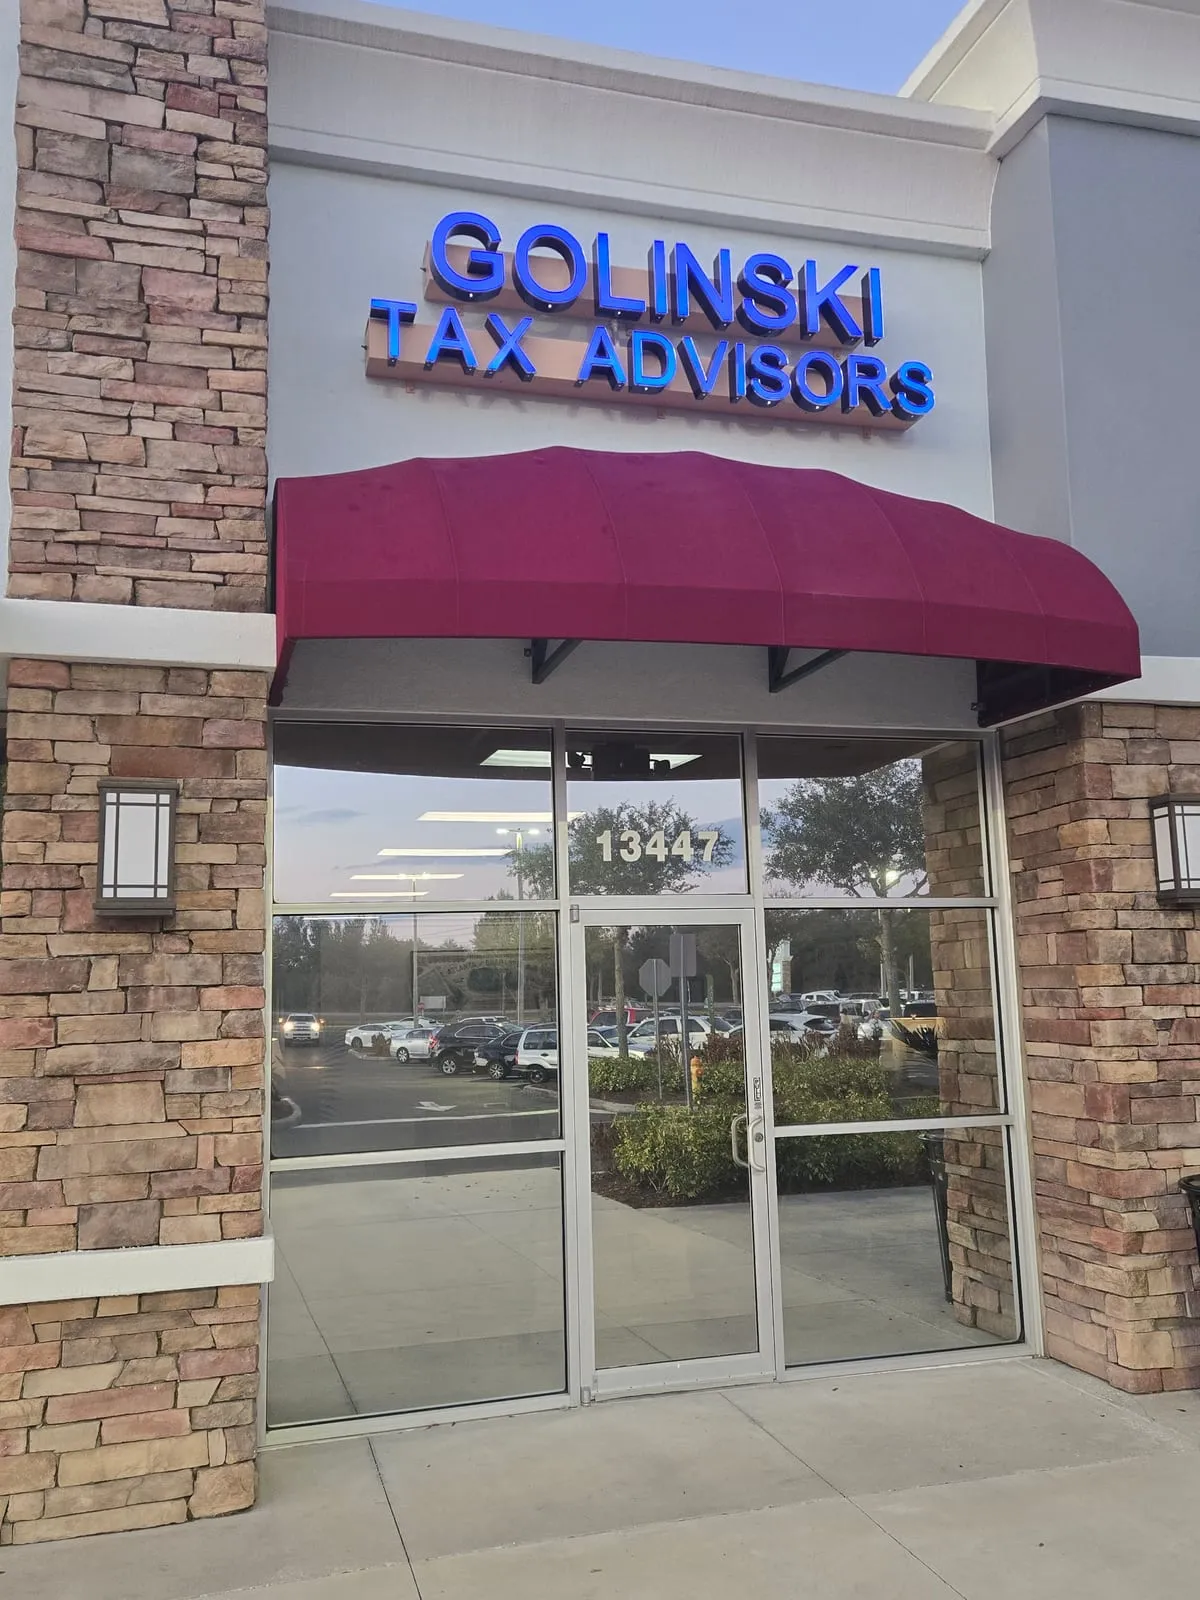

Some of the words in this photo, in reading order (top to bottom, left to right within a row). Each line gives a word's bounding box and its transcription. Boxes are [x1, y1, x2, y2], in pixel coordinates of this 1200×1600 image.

[430, 211, 885, 345] GOLINSKI
[370, 298, 536, 381] TAX
[576, 326, 936, 417] ADVISORS
[596, 830, 719, 863] 13447
